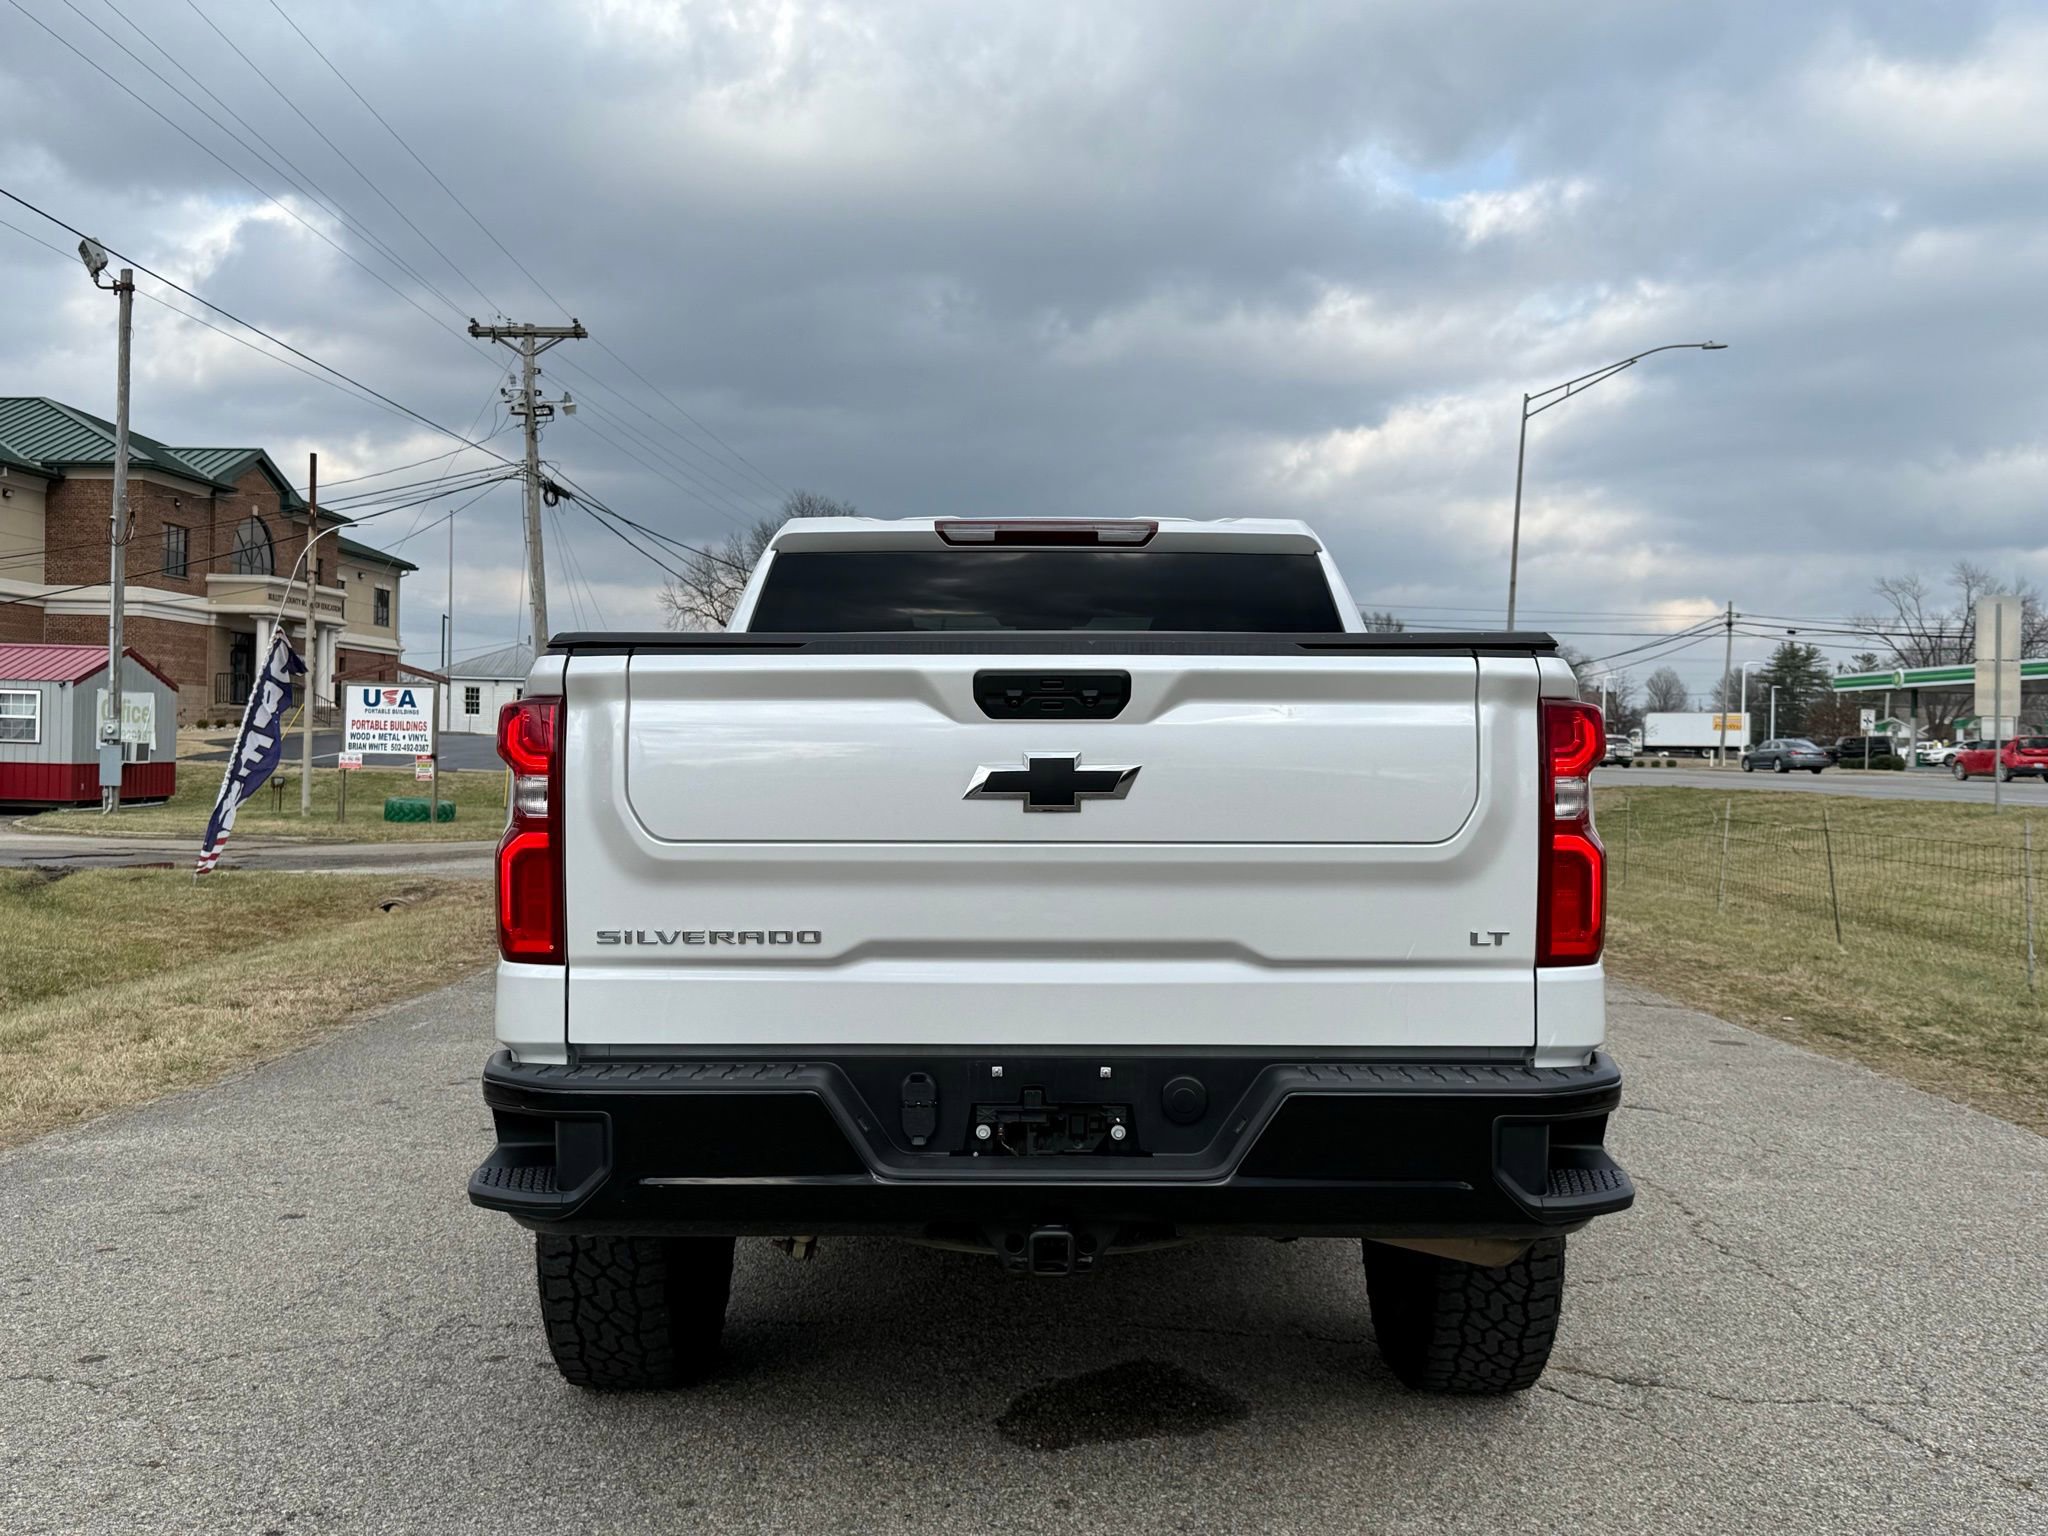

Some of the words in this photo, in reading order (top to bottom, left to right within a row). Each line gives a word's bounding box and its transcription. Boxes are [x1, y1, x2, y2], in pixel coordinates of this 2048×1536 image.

[363, 688, 417, 708] USA
[351, 719, 388, 731] PORTABLE
[390, 720, 428, 732] BUILDINGS
[350, 732, 371, 740] WOOD
[378, 733, 400, 741] METAL
[408, 733, 428, 742] VINYL
[348, 742, 367, 750] BRIAN
[368, 743, 388, 751] WHITE
[596, 930, 822, 945] SILVERADO
[1469, 930, 1510, 946] LT
